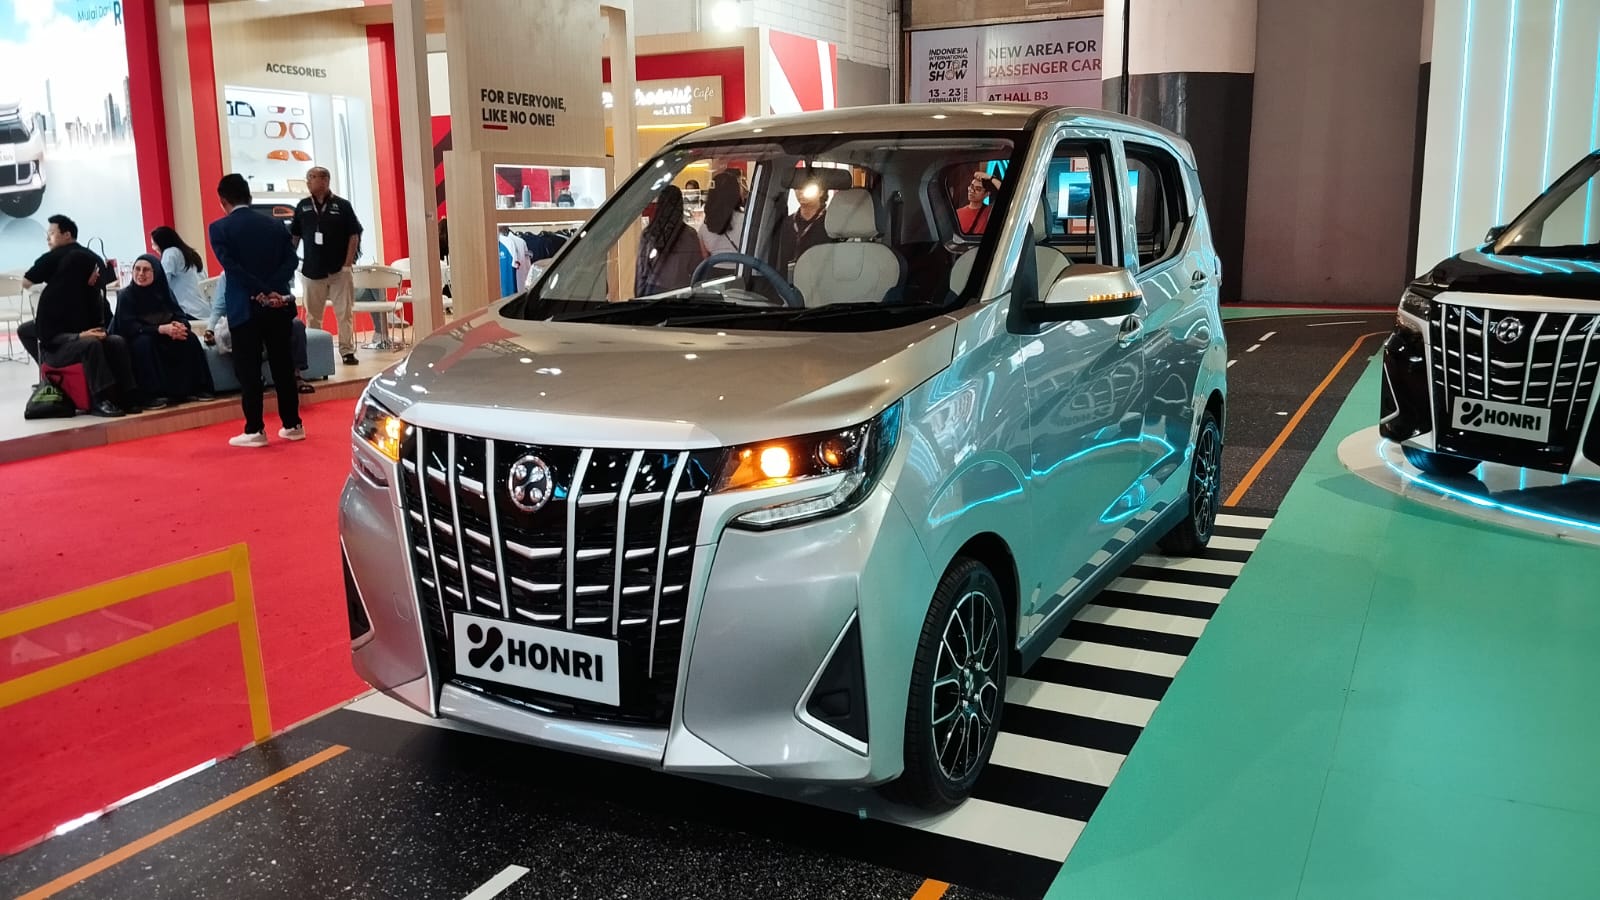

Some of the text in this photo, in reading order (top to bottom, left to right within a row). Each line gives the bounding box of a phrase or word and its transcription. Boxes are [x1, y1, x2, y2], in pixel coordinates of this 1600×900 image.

[928, 48, 969, 56] INDONESIA
[988, 40, 1097, 60] NEW AREA FOR
[266, 63, 327, 78] ACCESORIES
[928, 60, 969, 70] MOTOR
[988, 60, 1068, 78] PASSENGER
[928, 69, 968, 82] SHOW
[481, 88, 567, 113] FOR EVERYONE,
[928, 88, 940, 98] 13
[948, 88, 961, 97] 23
[988, 91, 1049, 102] AT HALL B3
[482, 107, 555, 127] LIKE NO ONE!
[1484, 408, 1542, 431] HONRI
[507, 638, 604, 682] HONRI
